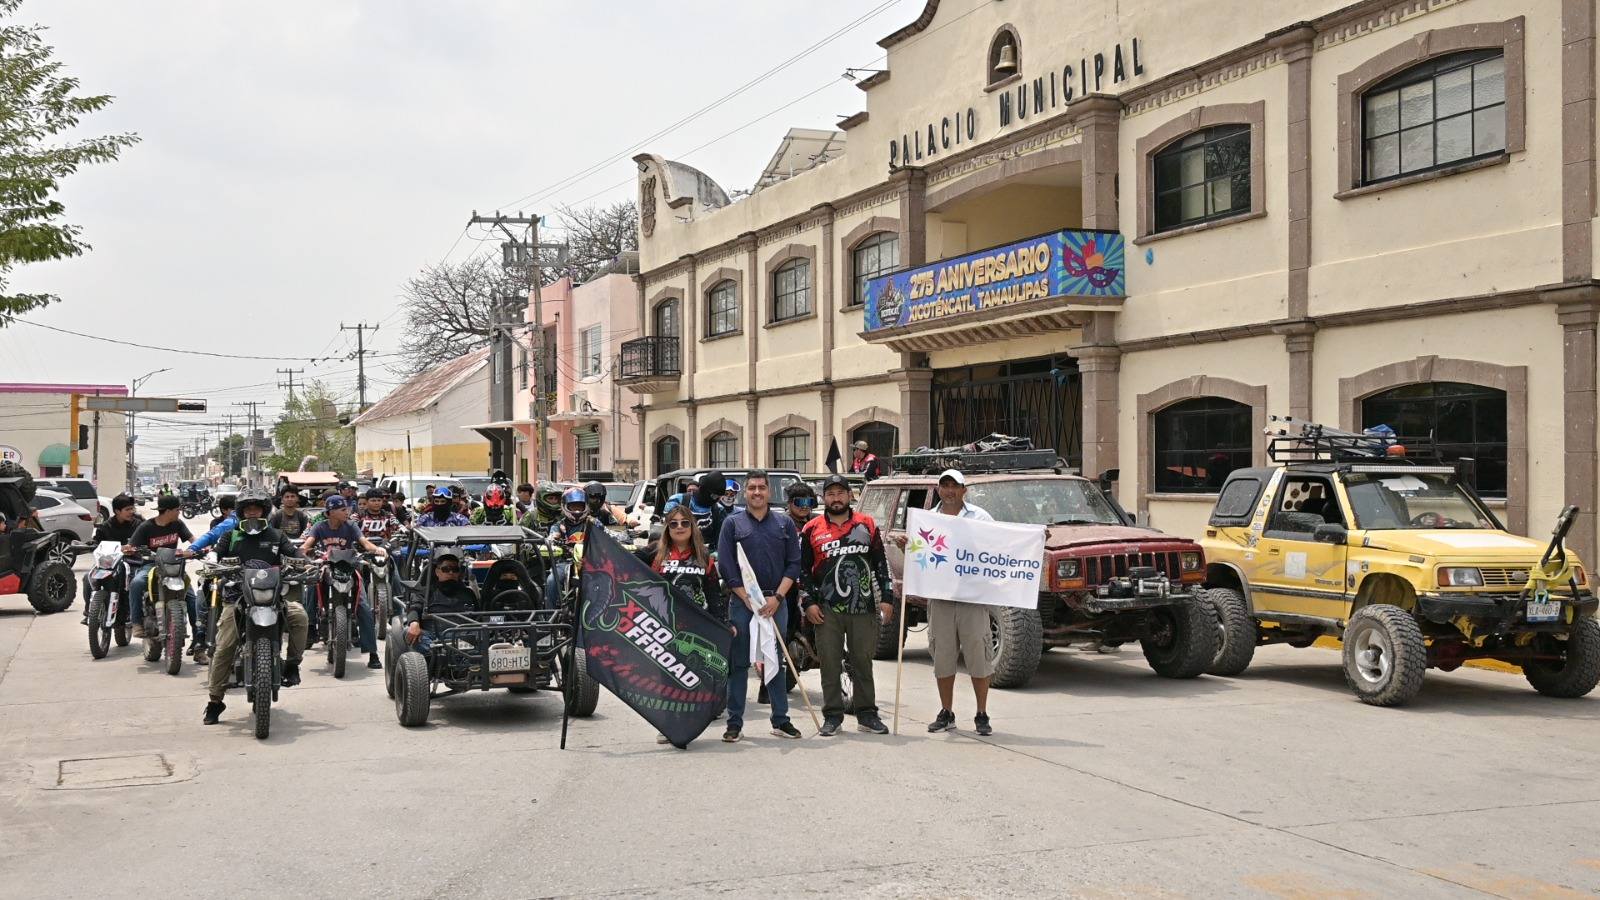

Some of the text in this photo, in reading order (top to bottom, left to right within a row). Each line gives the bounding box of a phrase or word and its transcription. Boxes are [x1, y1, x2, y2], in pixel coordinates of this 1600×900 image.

[890, 37, 1143, 166] PALACIO MUNICIPAL
[909, 242, 1050, 300] 275 ANIVERSARIO
[978, 278, 1049, 308] TAMAULIPAS
[361, 519, 388, 531] FOX
[954, 564, 1034, 580] que nos une
[956, 548, 1040, 569] Un Gobierno
[618, 600, 673, 644] XICO
[616, 617, 700, 687] OFFROAD
